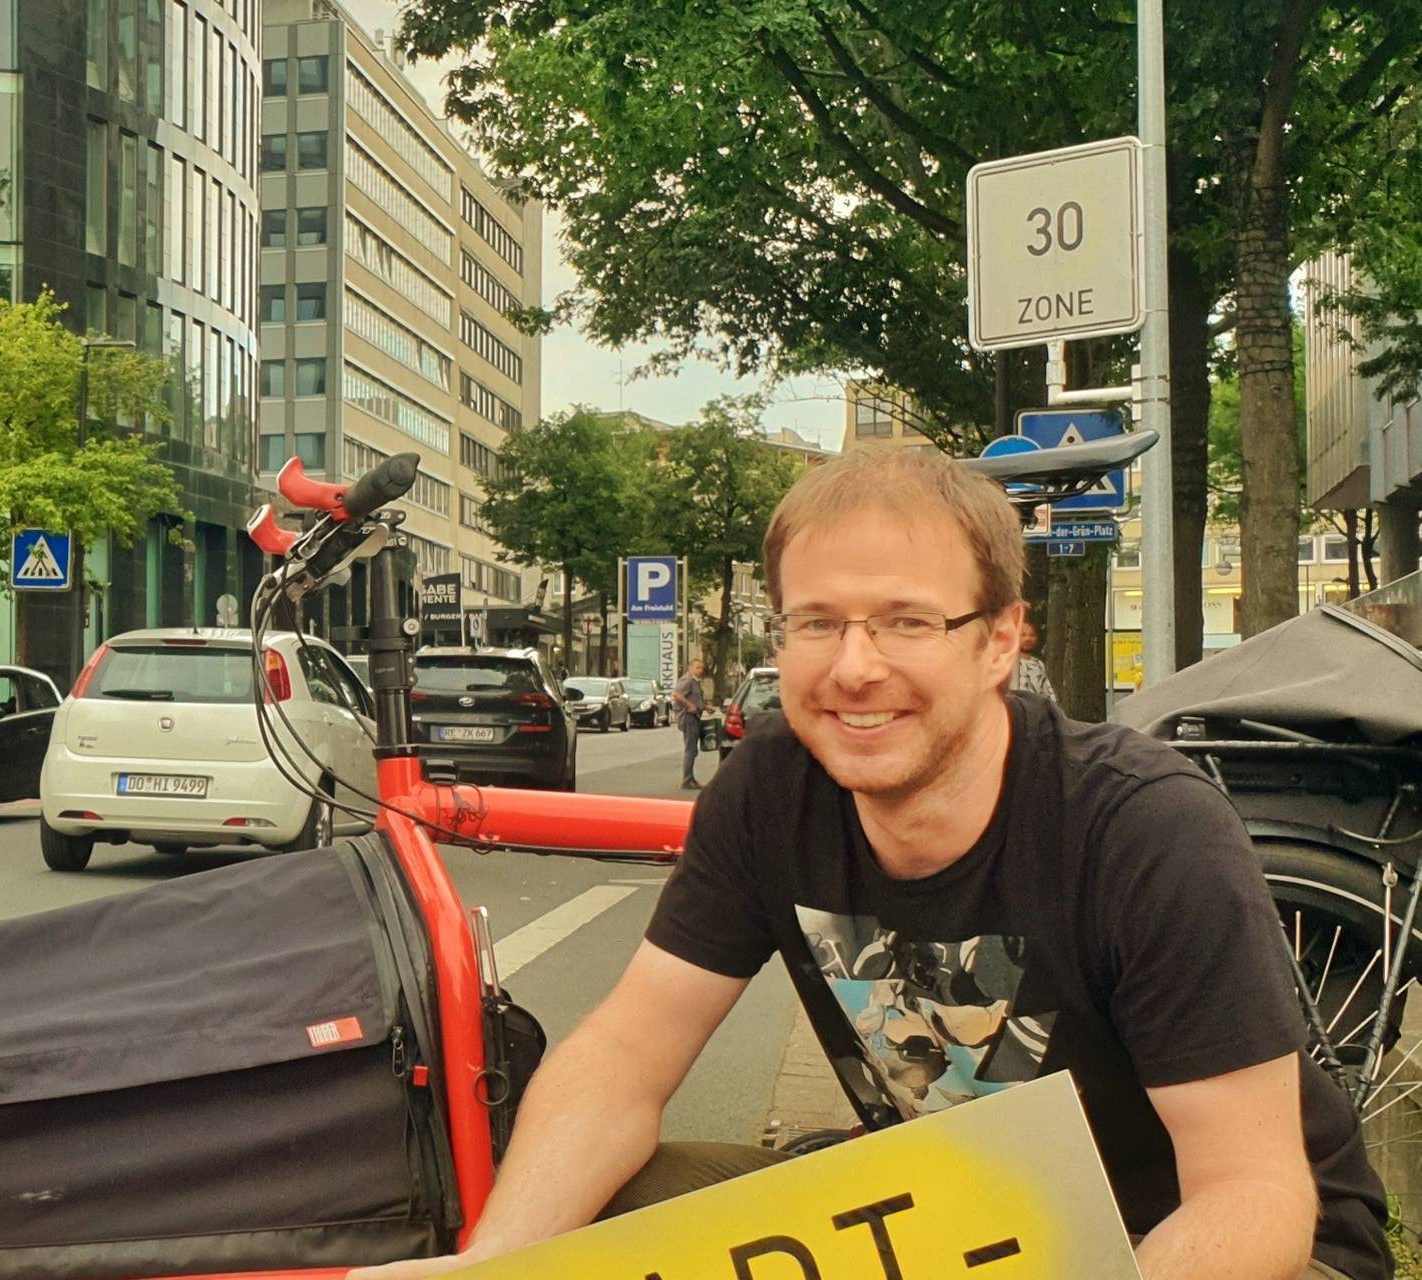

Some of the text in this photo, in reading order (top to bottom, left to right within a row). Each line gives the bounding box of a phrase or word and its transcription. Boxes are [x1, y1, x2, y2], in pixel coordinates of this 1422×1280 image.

[1026, 201, 1083, 256] 30
[1018, 288, 1094, 324] ZONE
[1049, 525, 1113, 537] -der-Grün-Platz
[637, 562, 671, 602] P
[661, 631, 674, 694] RKHAUS
[128, 776, 205, 793] DO HI 9499
